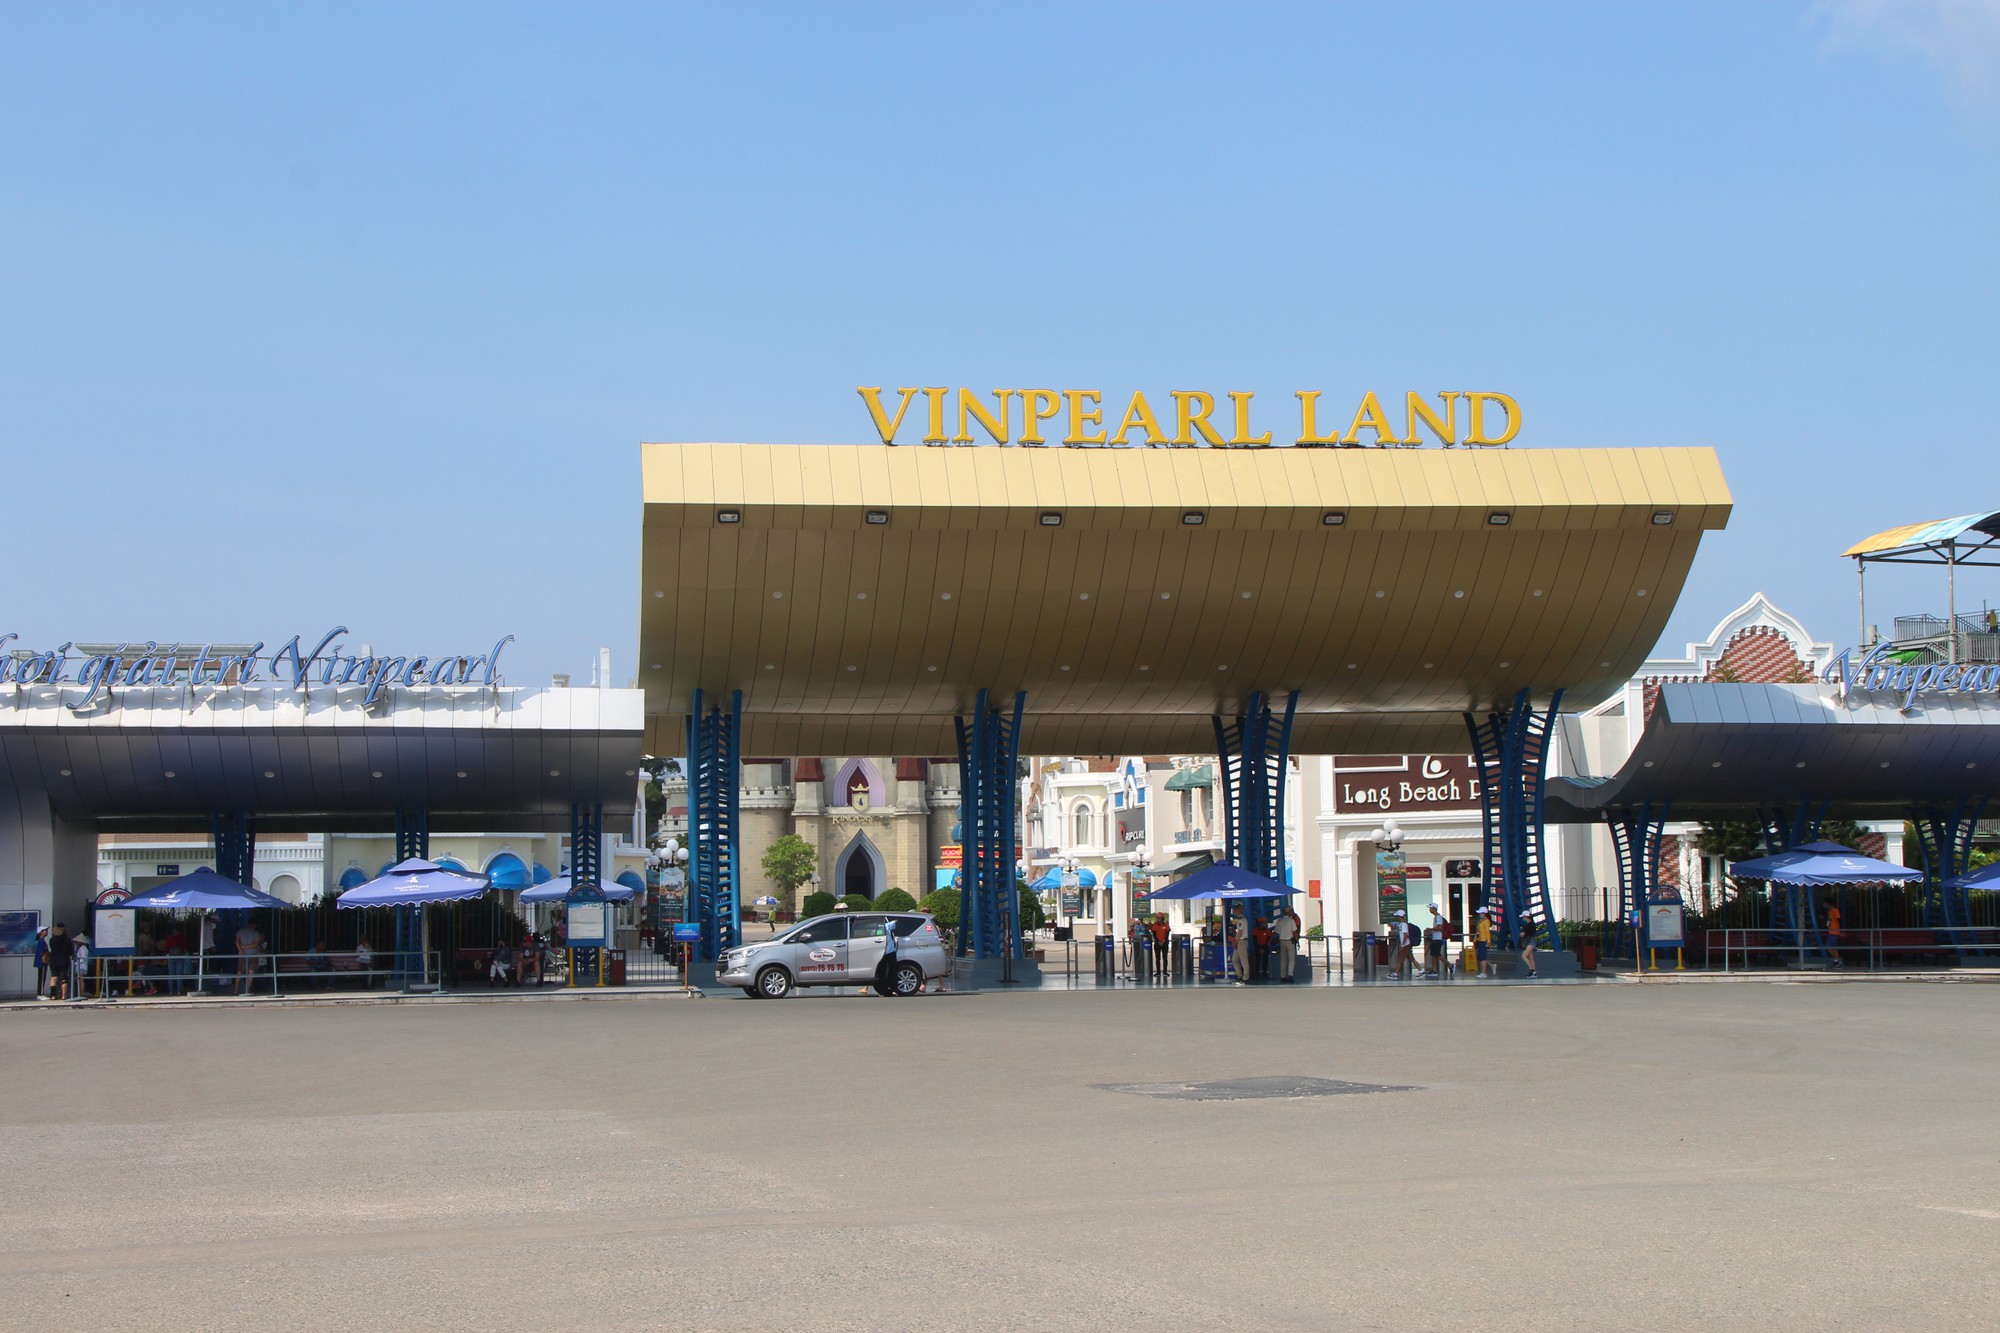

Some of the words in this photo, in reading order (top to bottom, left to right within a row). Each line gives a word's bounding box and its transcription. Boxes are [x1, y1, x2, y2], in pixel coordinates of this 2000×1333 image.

[856, 386, 1272, 447] VINPEARL
[1295, 390, 1522, 447] LAND
[66, 641, 181, 710] giải
[190, 641, 264, 686] trí
[269, 625, 515, 707] Vinpearl
[1344, 784, 1391, 810] Long
[1399, 778, 1460, 802] Beach
